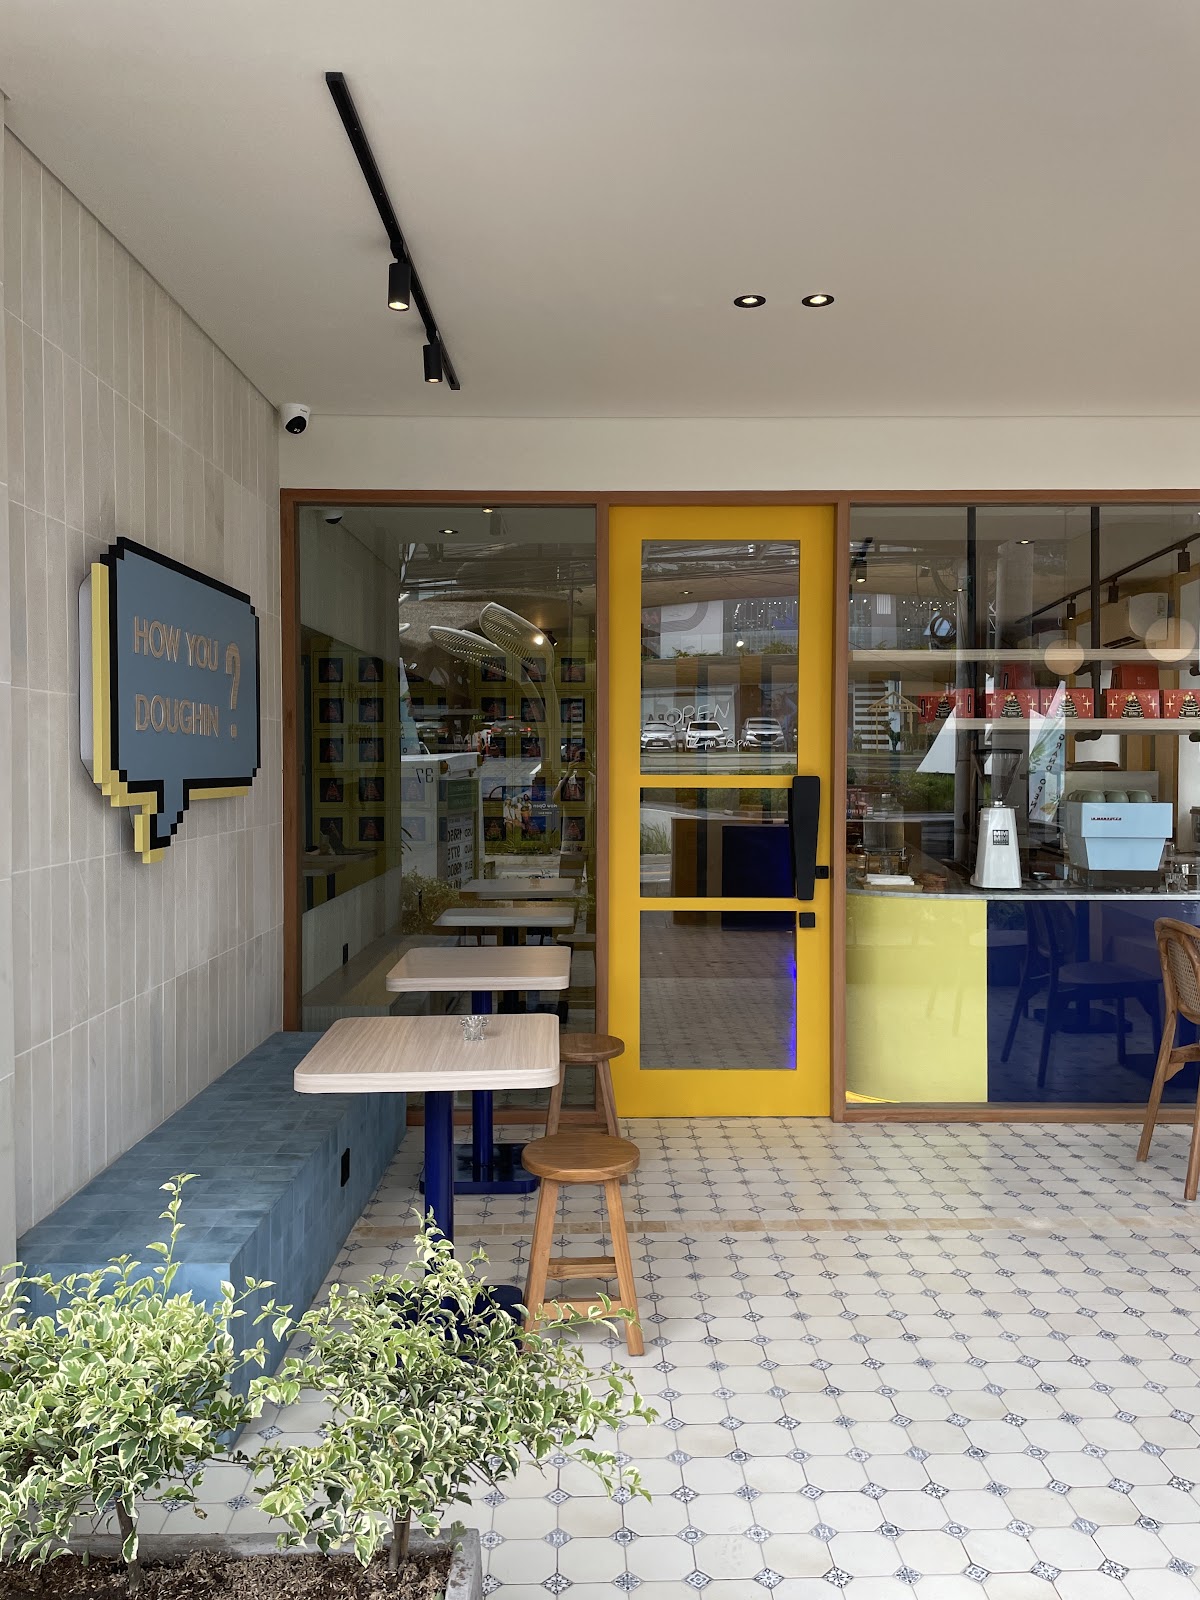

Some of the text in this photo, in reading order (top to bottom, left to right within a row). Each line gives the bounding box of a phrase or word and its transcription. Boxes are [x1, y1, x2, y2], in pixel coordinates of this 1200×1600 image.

[133, 615, 219, 672] HOW YOU
[135, 693, 219, 738] DOUGHIN
[665, 702, 730, 727] OPEN
